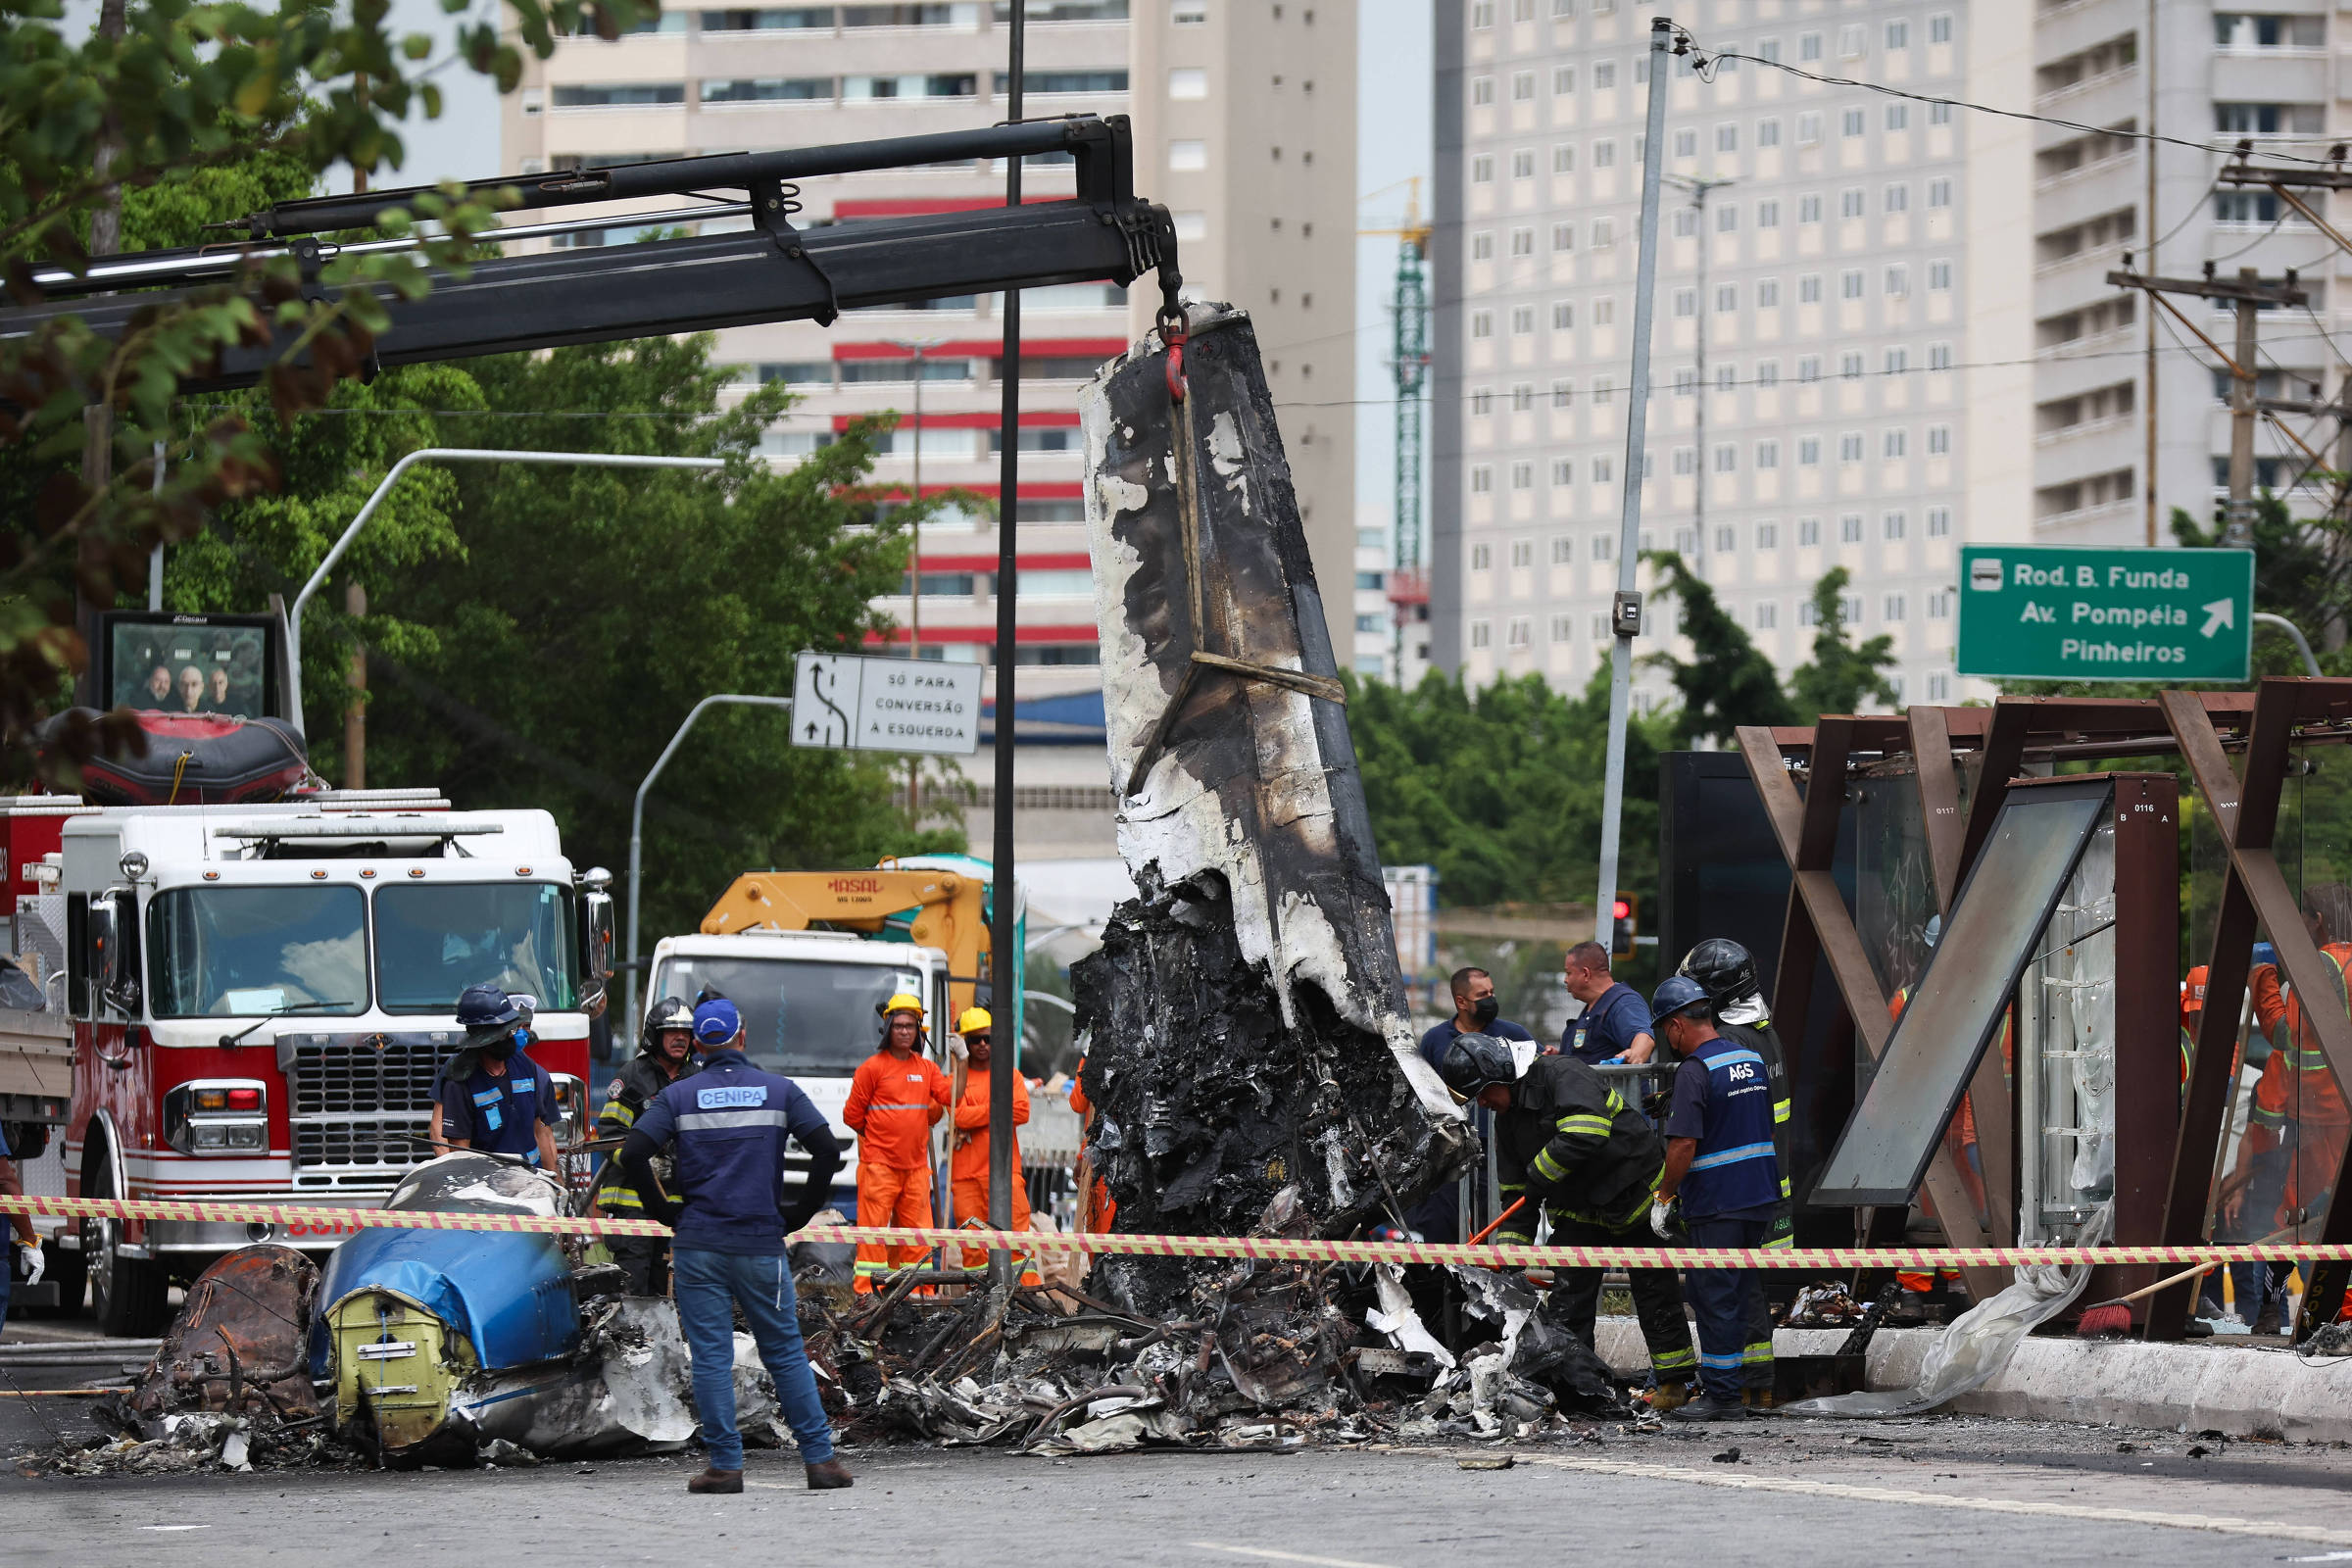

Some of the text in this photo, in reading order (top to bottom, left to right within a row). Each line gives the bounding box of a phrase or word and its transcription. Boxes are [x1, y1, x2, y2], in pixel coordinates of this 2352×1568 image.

[2014, 564, 2189, 589] Rod. B. Funda
[2020, 601, 2187, 629] Av. Pompéia
[2061, 639, 2185, 662] Pinheiros
[888, 670, 956, 689] SÓ PARA
[875, 697, 963, 714] CONVERSÃO
[870, 721, 963, 739] À ESQUERDA
[2134, 804, 2154, 812] 0116
[2120, 813, 2127, 822] B
[2161, 814, 2169, 823] A
[1729, 1062, 1754, 1082] AGS
[701, 1090, 763, 1105] CENIPA
